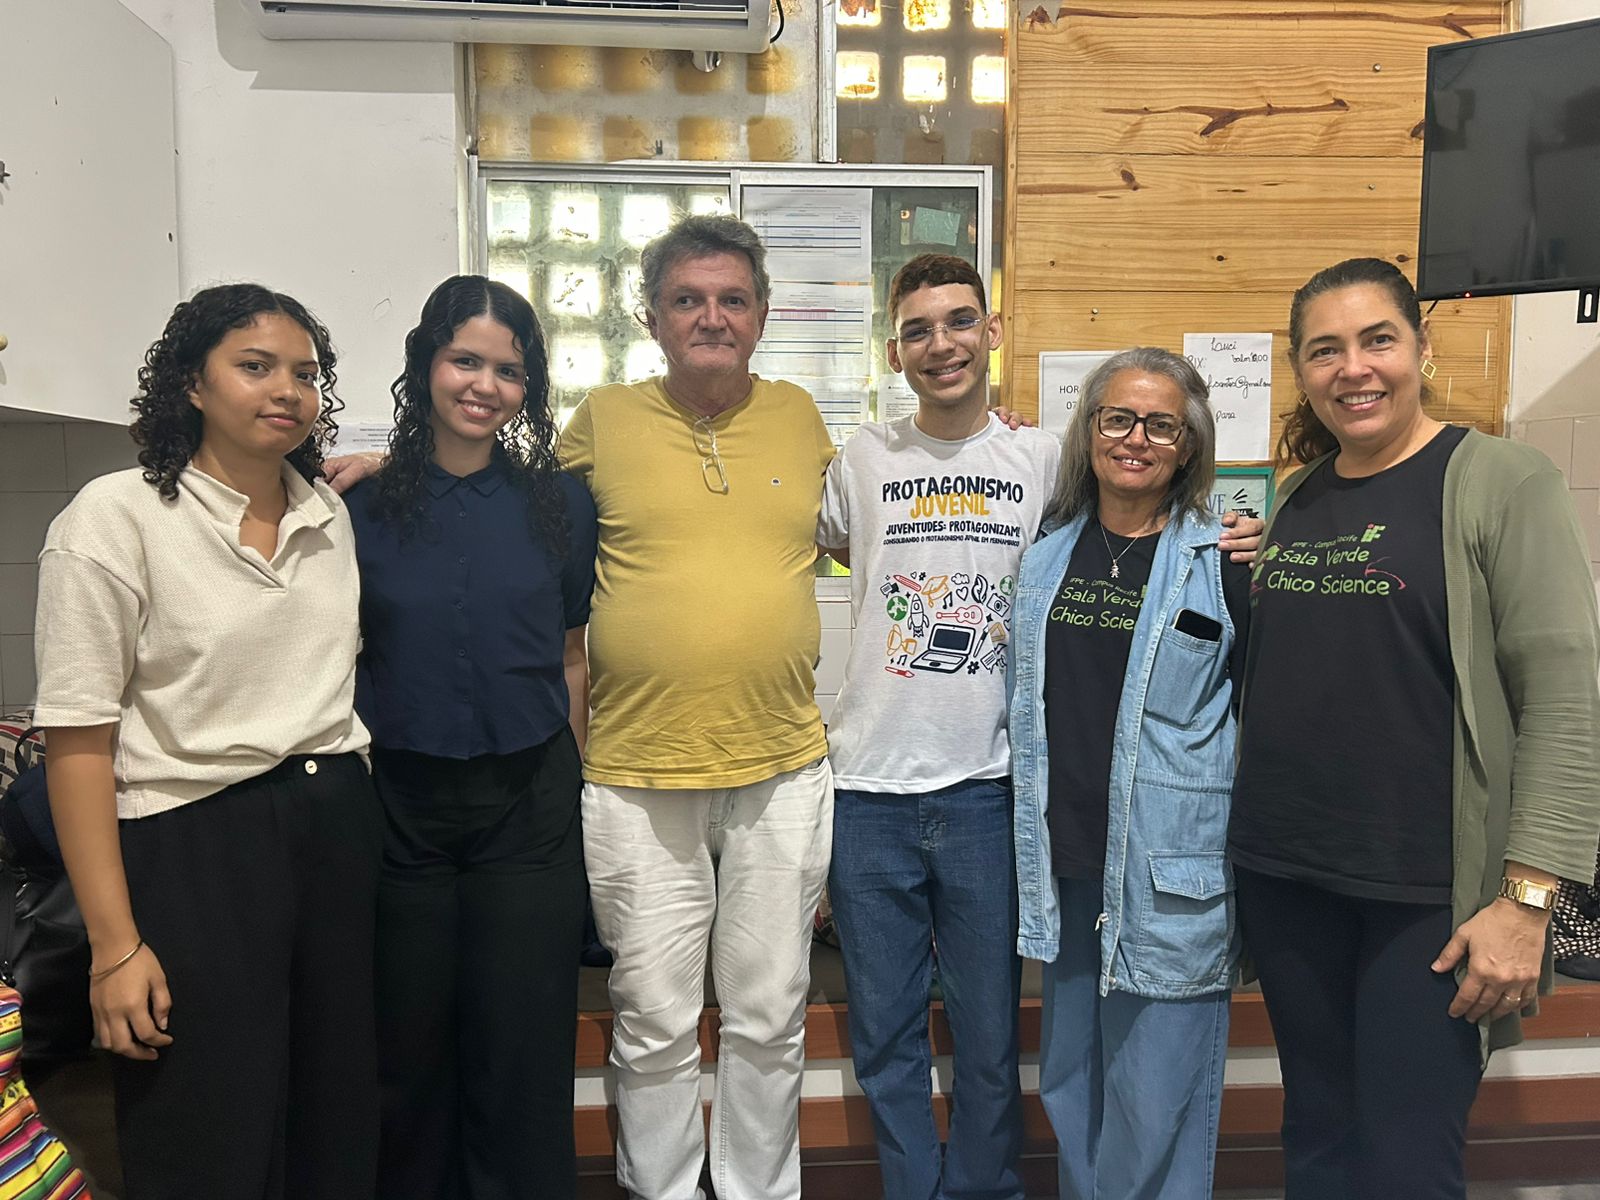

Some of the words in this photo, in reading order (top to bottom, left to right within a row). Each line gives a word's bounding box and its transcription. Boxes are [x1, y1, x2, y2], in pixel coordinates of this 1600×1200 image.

[1059, 385, 1080, 394] HOR
[882, 476, 1023, 503] PROTAGONISMO
[910, 492, 990, 519] JUVENIL
[886, 521, 946, 535] JUVENTUDES:
[1279, 550, 1318, 566] Sala
[1326, 546, 1369, 567] Verde
[1267, 570, 1315, 593] Chico
[1320, 574, 1390, 595] Science
[1061, 586, 1097, 604] Sala
[1103, 589, 1143, 609] Verd
[1050, 606, 1094, 627] Chico
[1099, 610, 1136, 631] Scie
